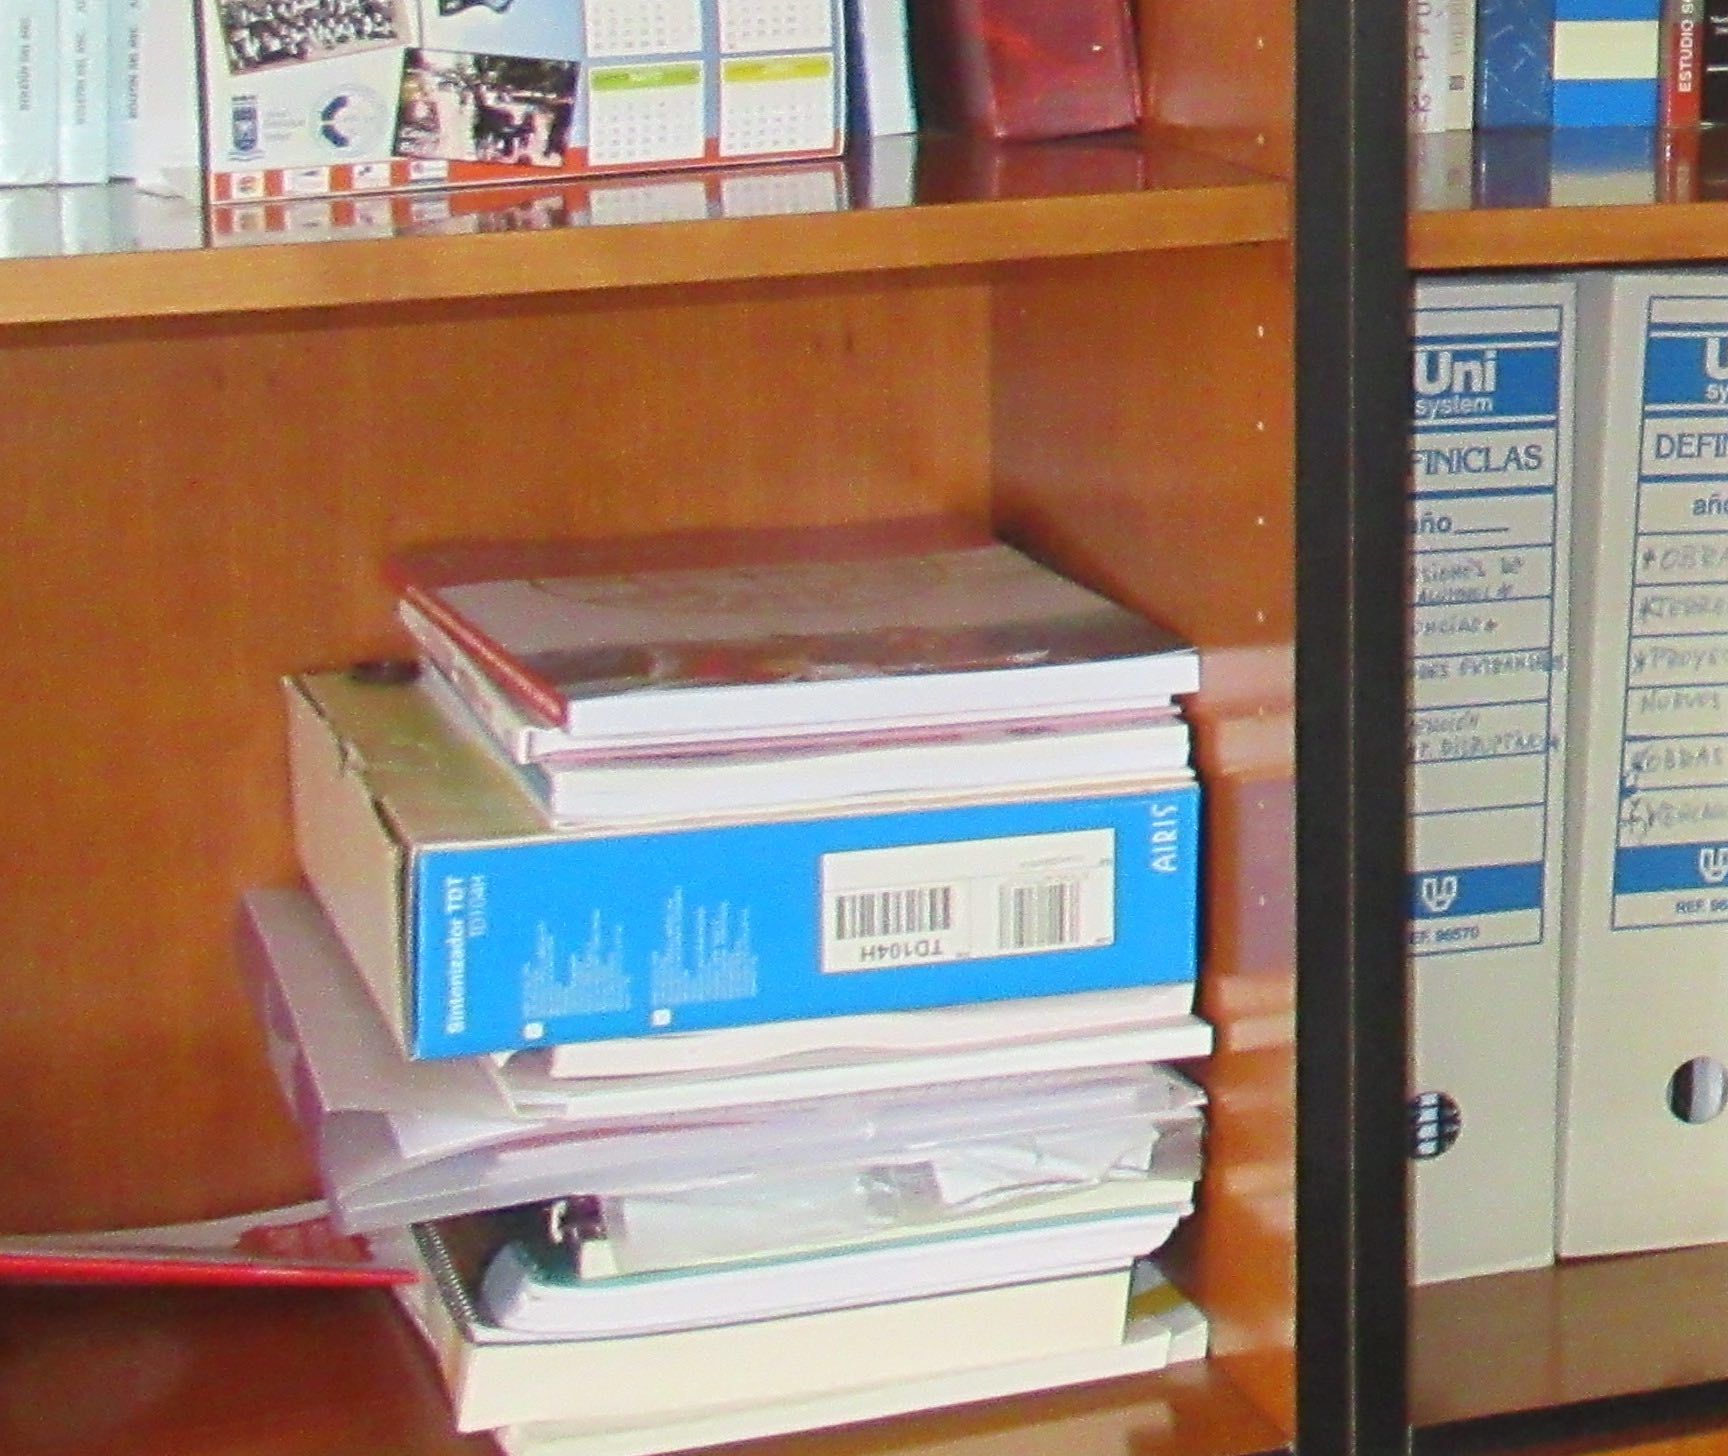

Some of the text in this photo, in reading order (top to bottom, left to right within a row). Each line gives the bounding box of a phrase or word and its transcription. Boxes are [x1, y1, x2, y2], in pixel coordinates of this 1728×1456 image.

[1678, 18, 1695, 93] ESTUDIO
[1414, 347, 1499, 398] Uni
[1150, 803, 1180, 873] AIRIS
[446, 875, 467, 1035] Sintonizador TDT
[861, 939, 943, 963] TD104H
